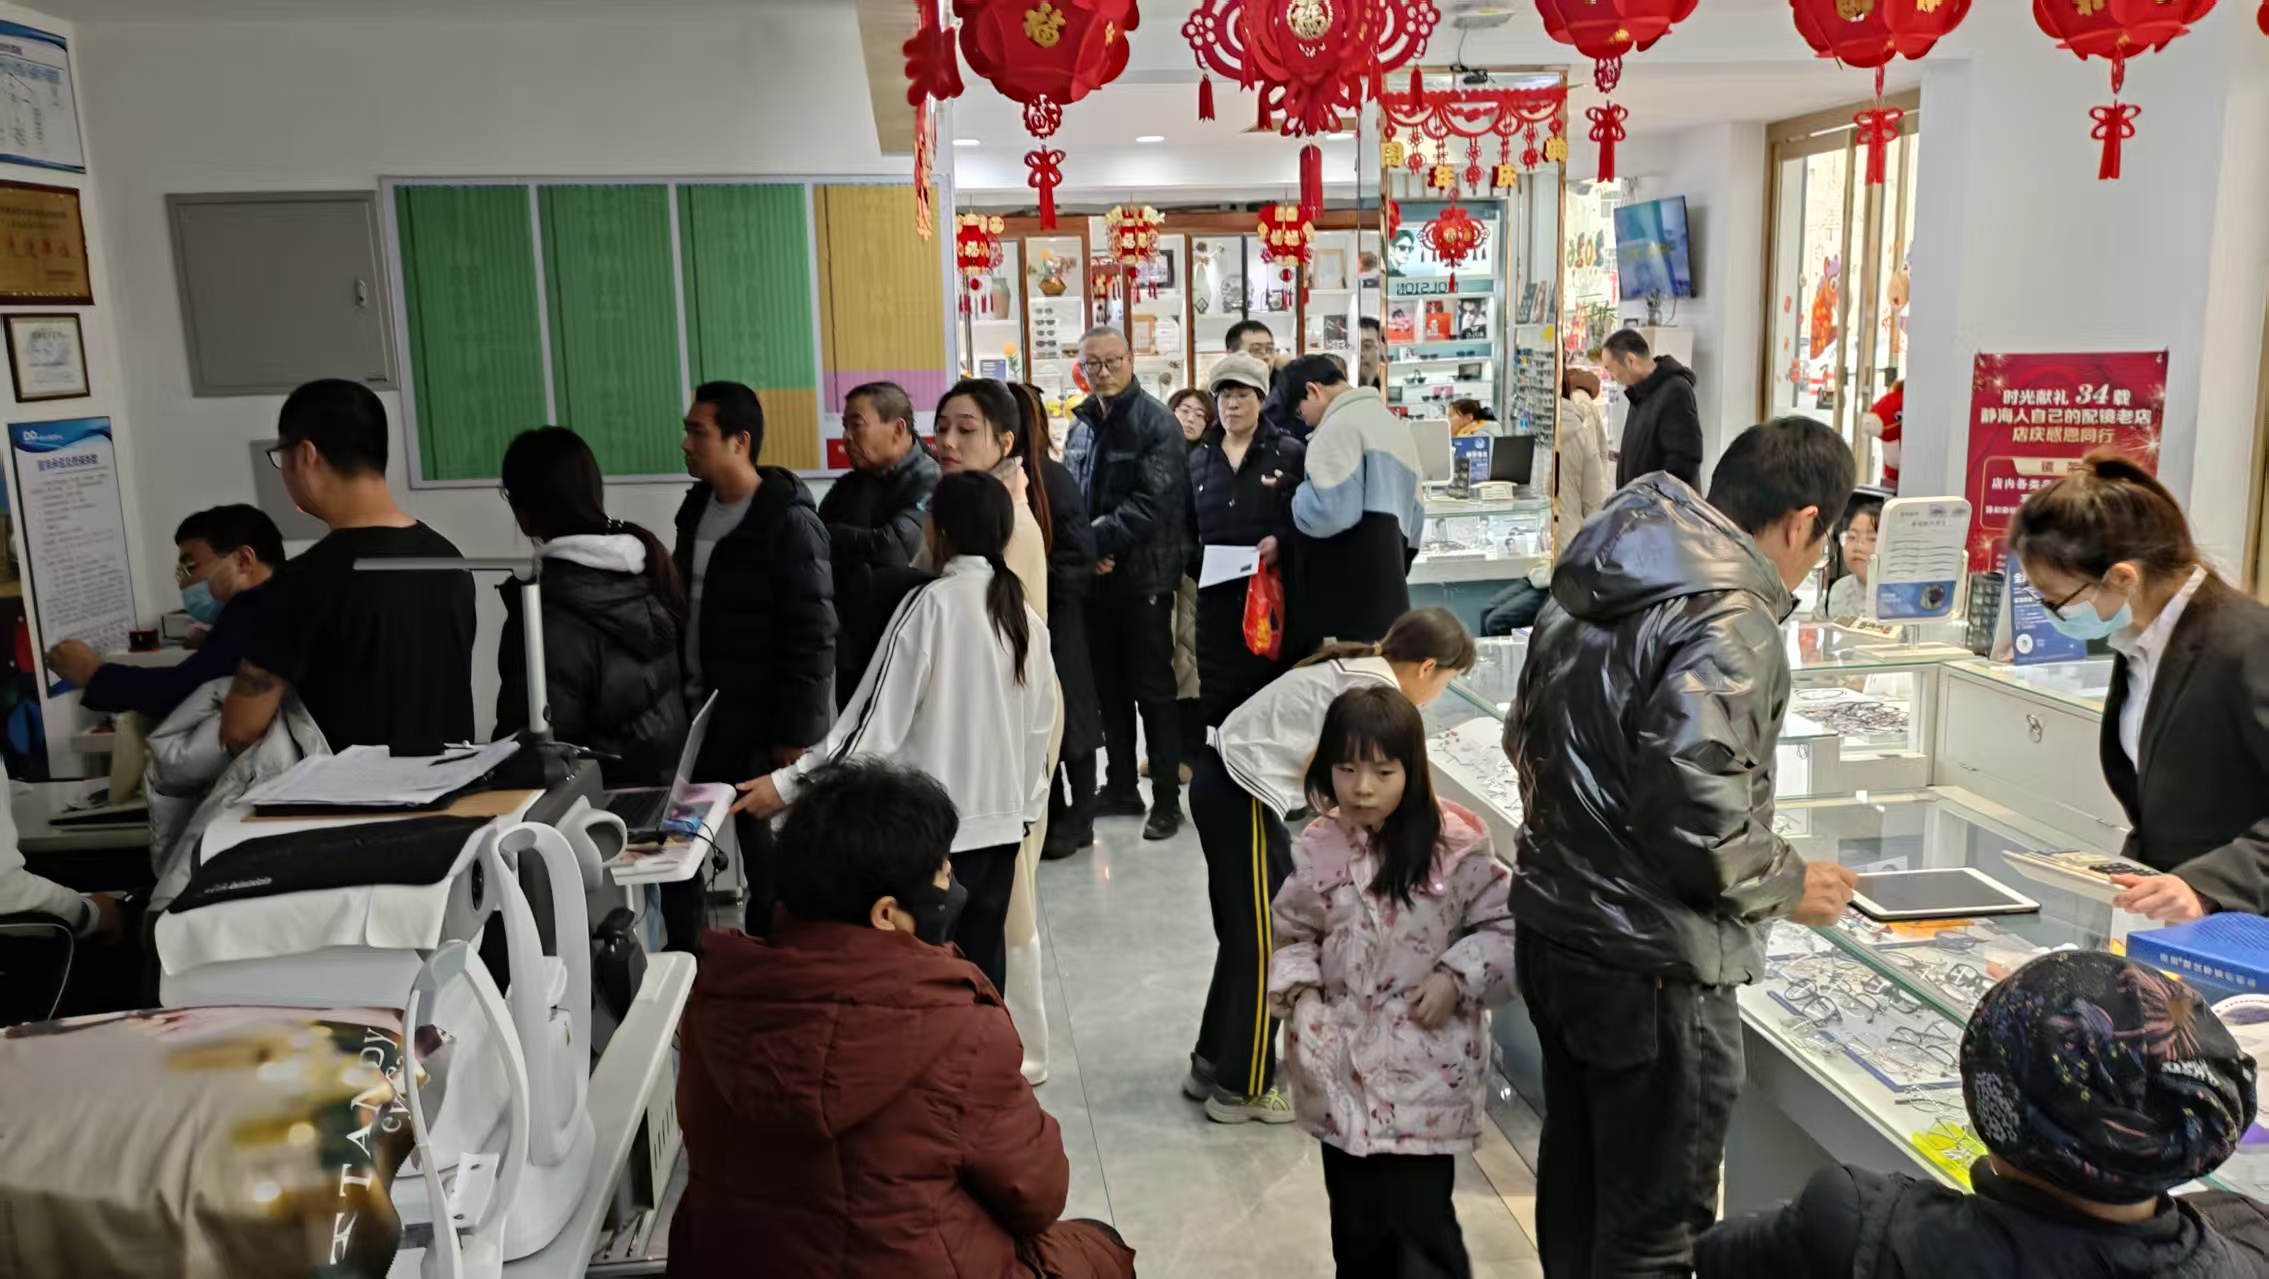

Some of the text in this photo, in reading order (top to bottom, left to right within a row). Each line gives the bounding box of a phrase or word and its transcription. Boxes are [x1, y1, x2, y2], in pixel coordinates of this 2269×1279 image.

[2003, 383, 2131, 406] 时光献礼 34 载
[1980, 408, 2152, 424] 静海人自己的配镜老店
[2012, 427, 2115, 443] 店庆感恩同行
